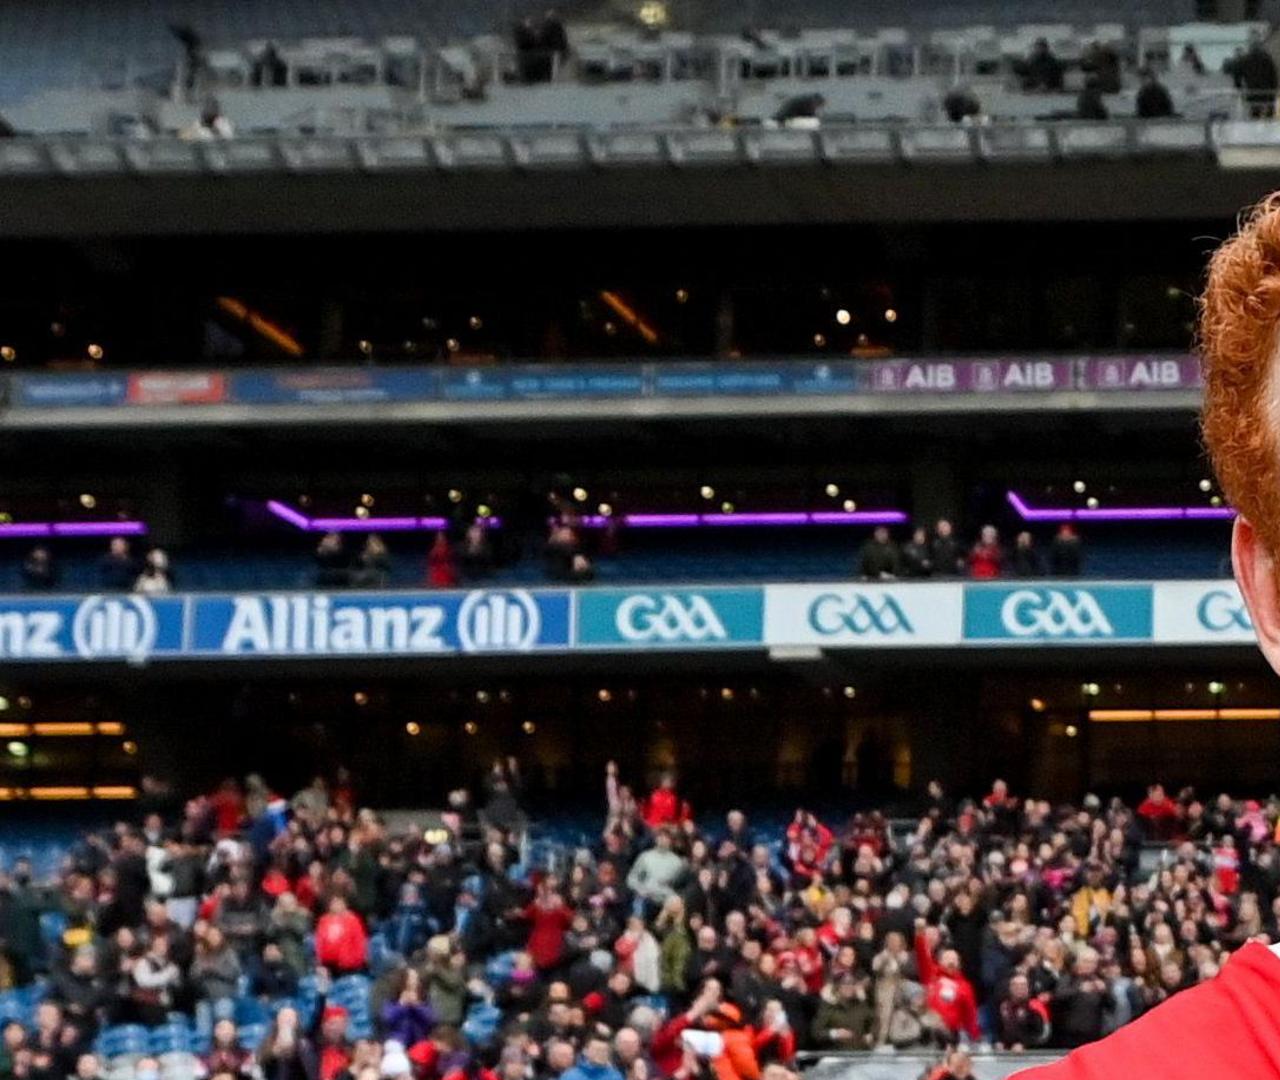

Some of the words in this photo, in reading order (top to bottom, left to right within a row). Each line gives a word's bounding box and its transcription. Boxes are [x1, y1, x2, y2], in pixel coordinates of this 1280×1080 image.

[905, 364, 956, 389] AIB
[1004, 362, 1055, 387] AIB
[1130, 360, 1181, 385] AIB
[221, 597, 445, 654] Allianz
[616, 593, 727, 640] GAA
[807, 592, 915, 637] GAA
[1001, 590, 1114, 638] GAA
